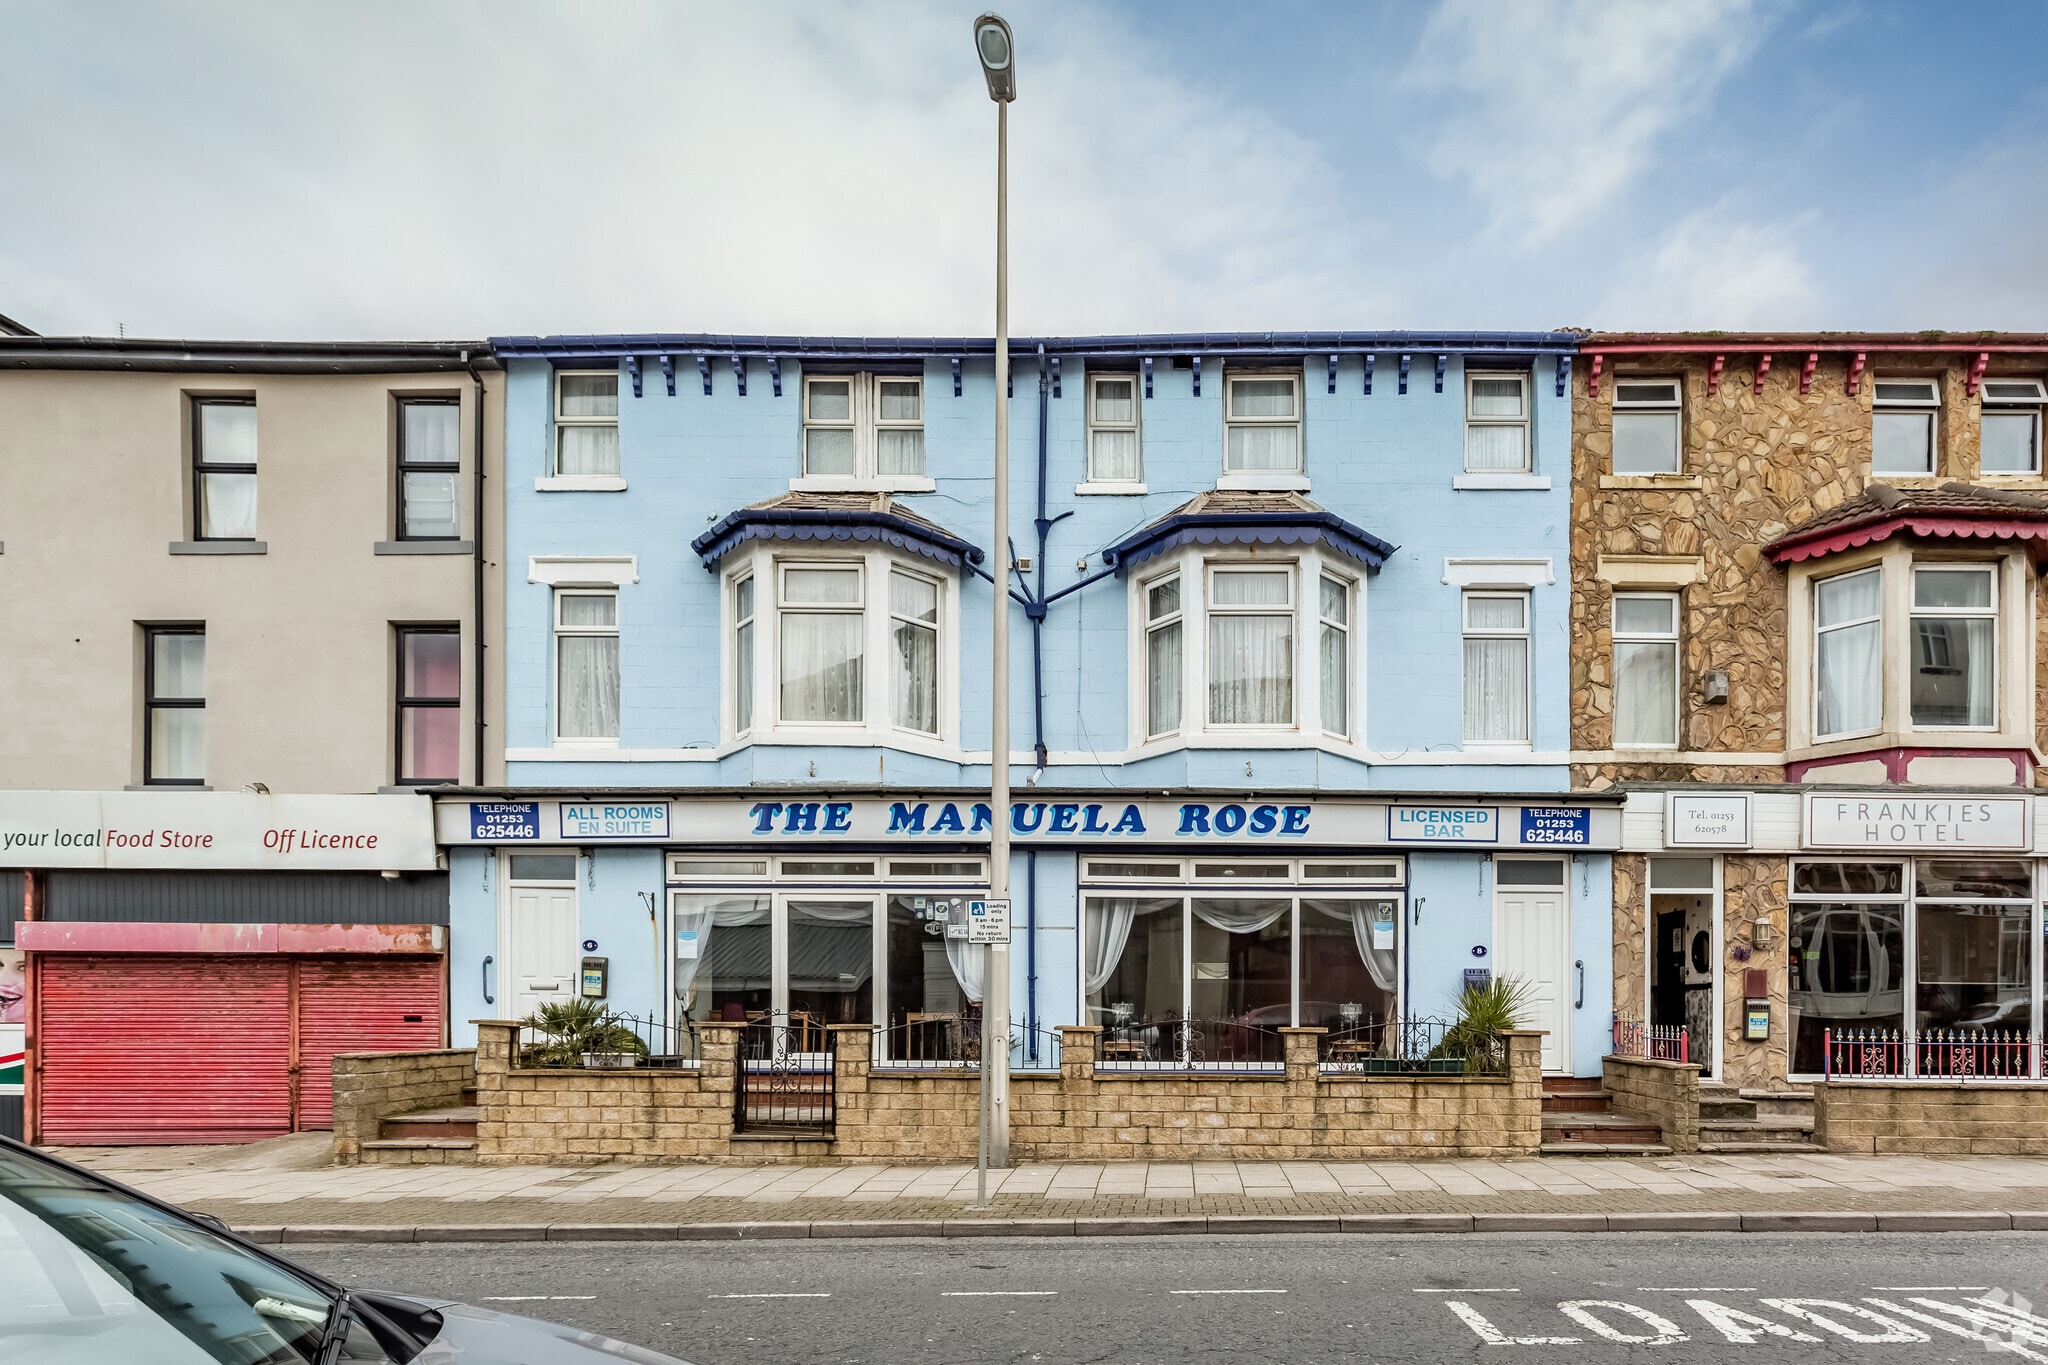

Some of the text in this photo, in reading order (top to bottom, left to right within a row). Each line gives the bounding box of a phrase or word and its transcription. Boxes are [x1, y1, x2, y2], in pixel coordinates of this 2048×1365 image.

[477, 804, 532, 813] TELEPHONE
[567, 806, 664, 820] ALL ROOMS
[1528, 808, 1583, 818] TELEPHONE
[1688, 810, 1735, 821] Tel. 01253
[1837, 802, 1992, 823] FRANKIES
[486, 814, 524, 823] 01253
[748, 802, 853, 836] THE
[1175, 803, 1312, 838] ROSE
[1399, 809, 1489, 824] LICENSED
[1536, 819, 1575, 828] 01253
[476, 824, 534, 838] 625446
[578, 820, 652, 834] EN SUITE
[1423, 824, 1465, 838] BAR
[1695, 825, 1727, 835] 620578
[1865, 823, 1966, 842] HOTEL
[3, 828, 214, 851] your local Food Store
[262, 829, 379, 853] Off Licence
[1525, 829, 1584, 843] 625446
